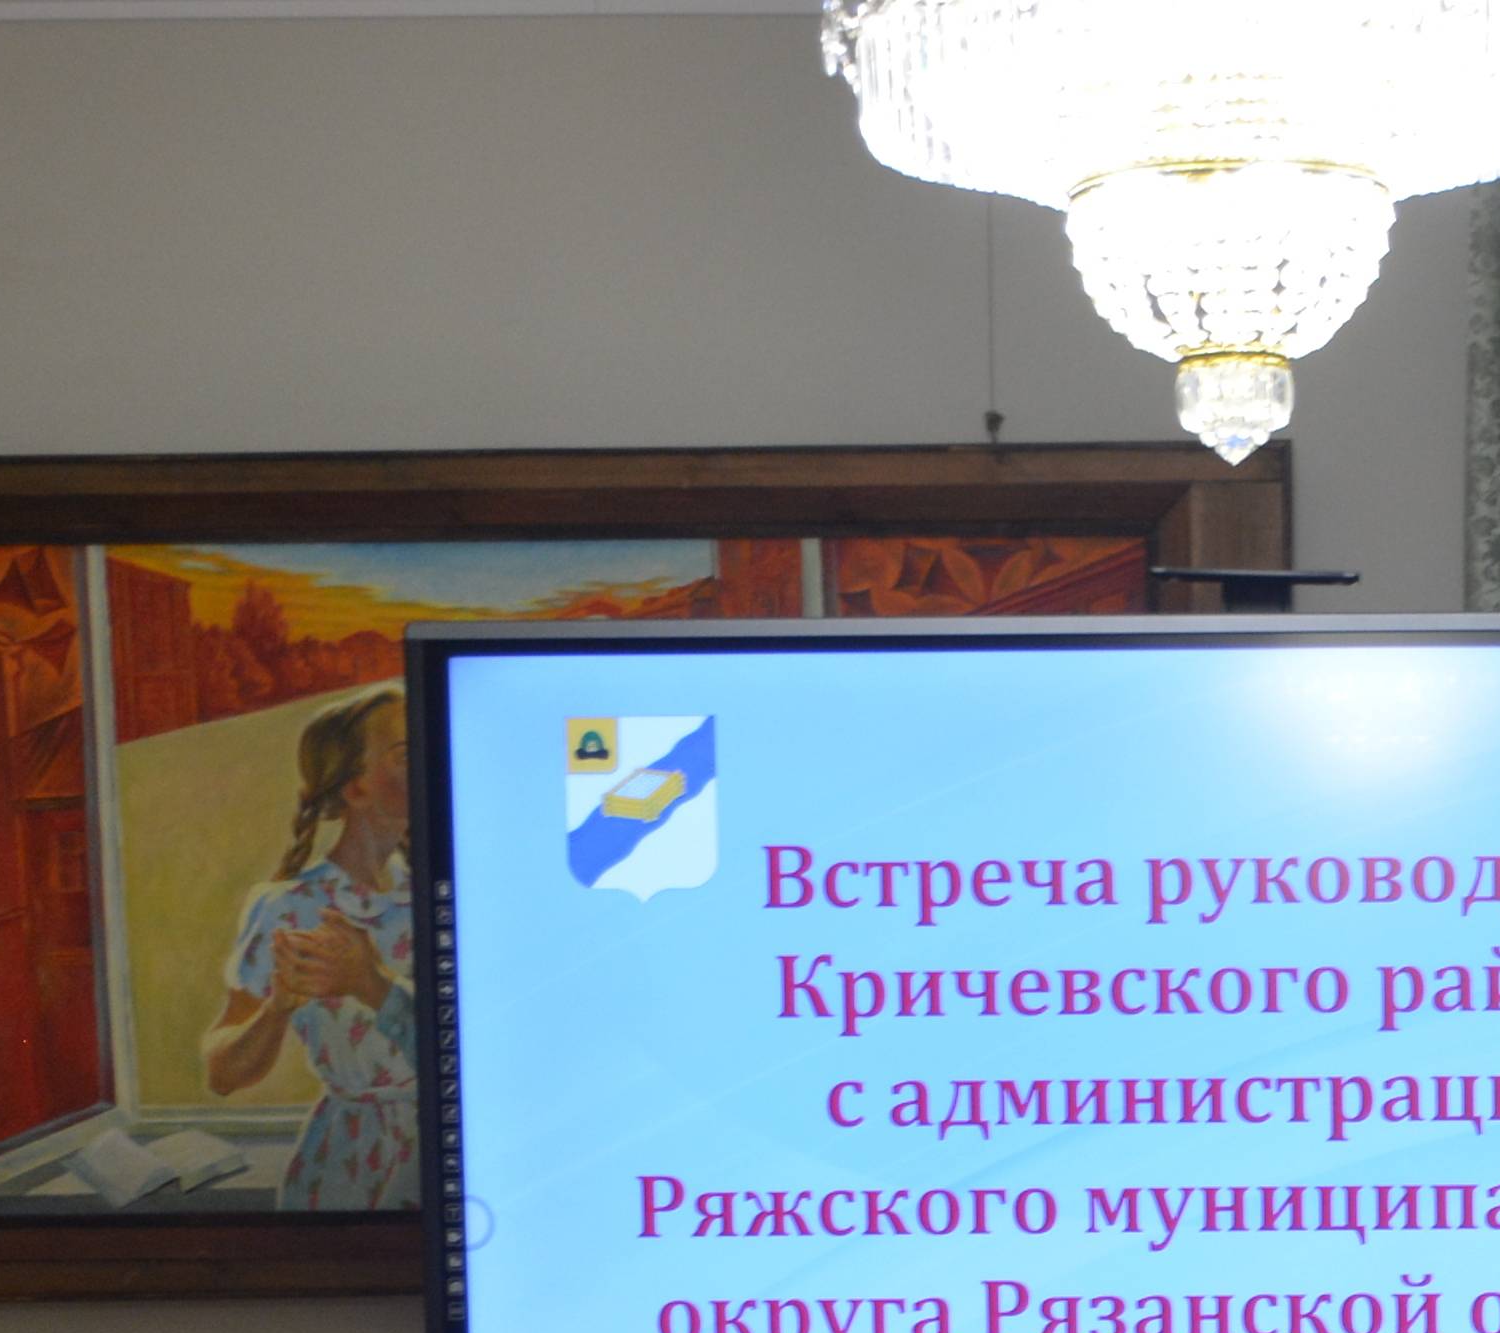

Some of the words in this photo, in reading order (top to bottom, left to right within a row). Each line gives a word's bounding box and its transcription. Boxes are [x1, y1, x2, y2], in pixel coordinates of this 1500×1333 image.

[762, 842, 1118, 926] Встреча
[775, 952, 1352, 1037] Кричевского
[826, 1079, 867, 1128] с
[636, 1175, 1059, 1240] Ряжского
